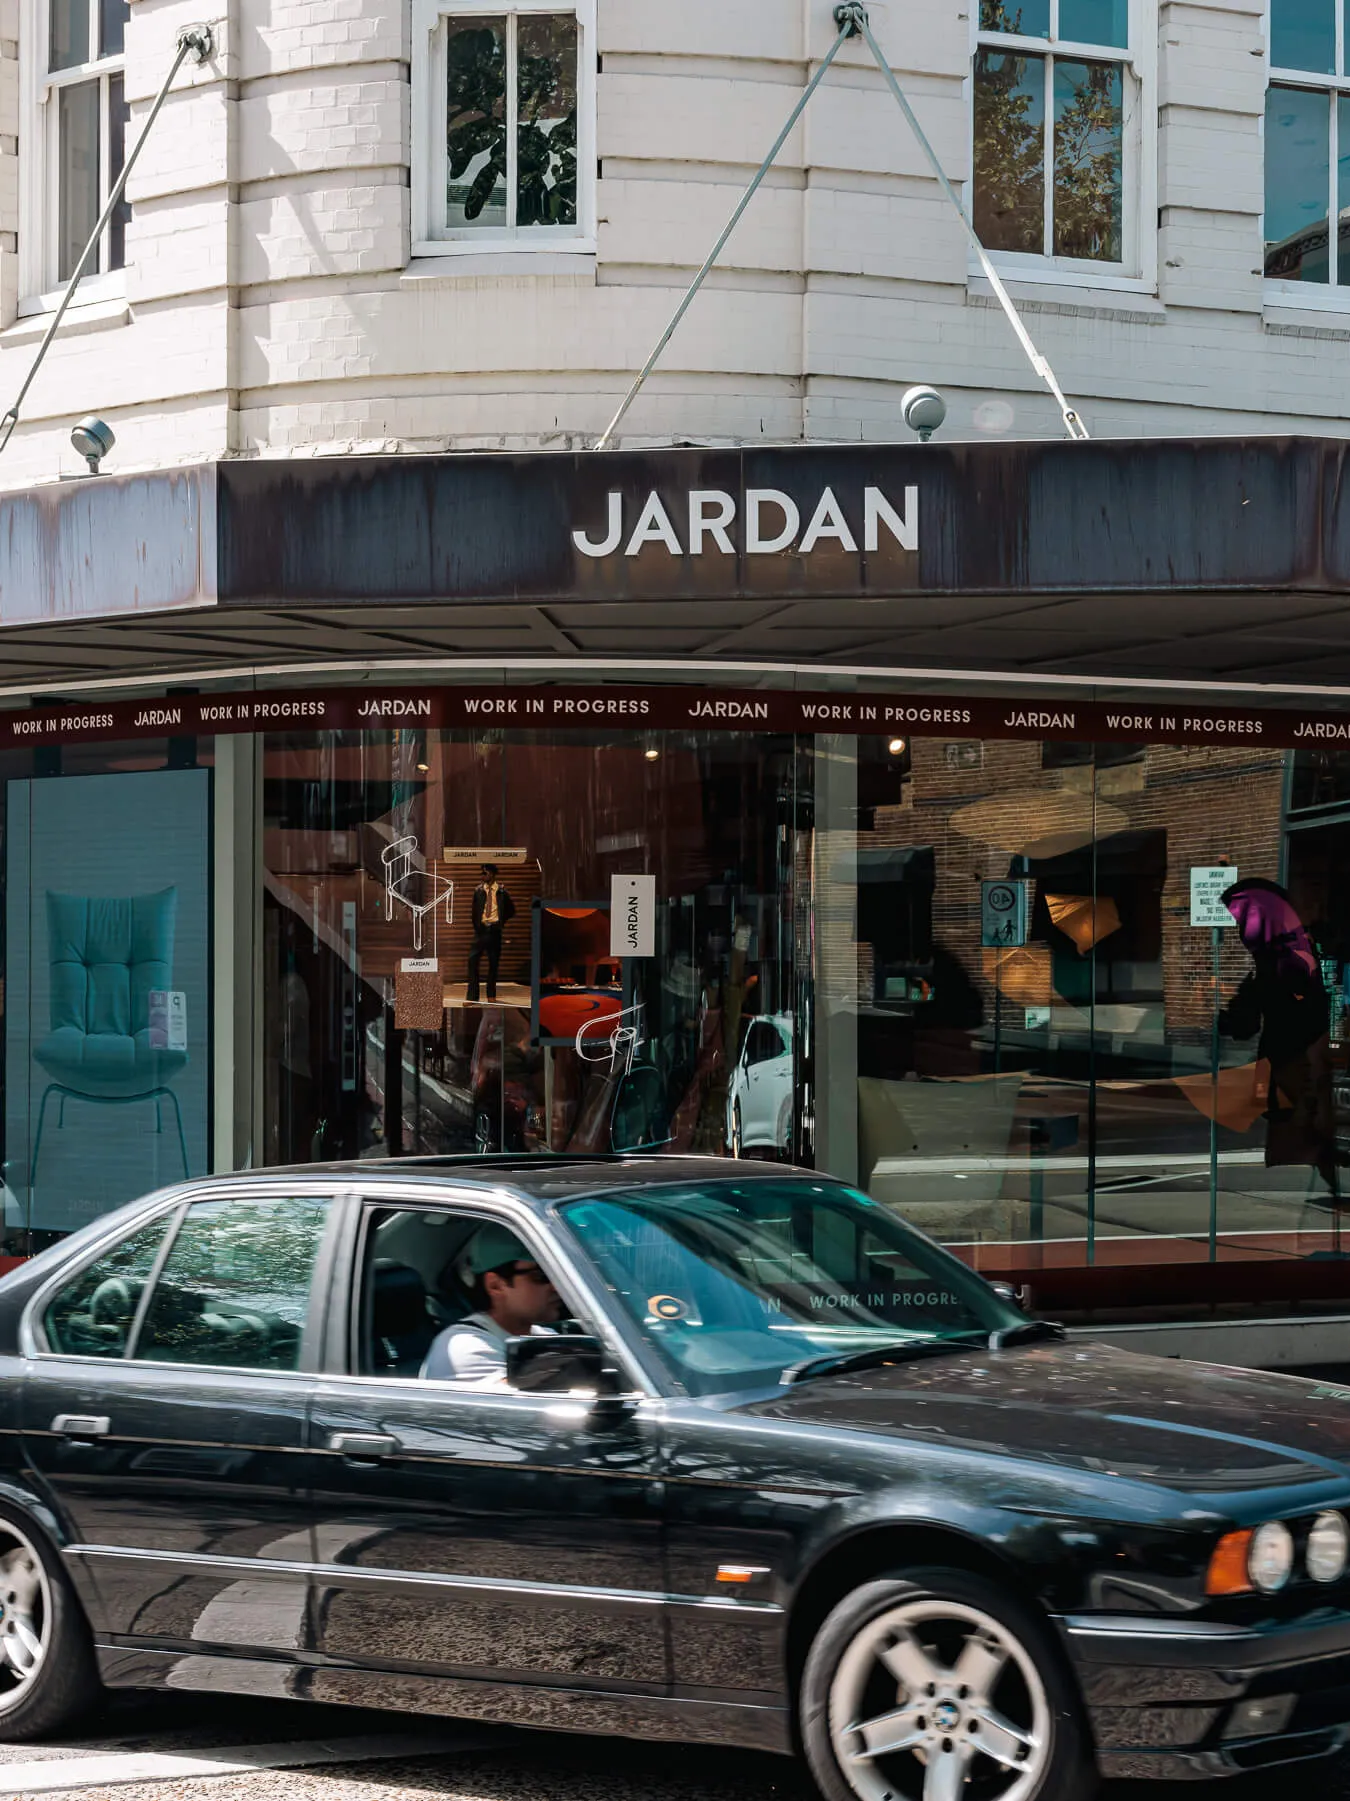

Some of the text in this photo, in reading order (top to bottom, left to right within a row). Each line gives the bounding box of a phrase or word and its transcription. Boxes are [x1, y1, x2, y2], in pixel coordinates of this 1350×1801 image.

[572, 486, 918, 557] JARDAN
[199, 701, 325, 721] WORK IN PROGRESS
[357, 699, 431, 716] JARDAN
[464, 699, 649, 714] WORK IN PROGRESS
[688, 700, 768, 719] JARDAN
[801, 704, 971, 723] WORK IN PROGRESS
[12, 713, 114, 735] WORK IN PROGRESS
[134, 708, 181, 727] JARDAN
[1004, 711, 1075, 729] JARDAN
[1106, 715, 1263, 734] WORK IN PROGRESS
[627, 896, 639, 948] JARDAN
[809, 1295, 859, 1309] WORK
[867, 1293, 885, 1306] IN
